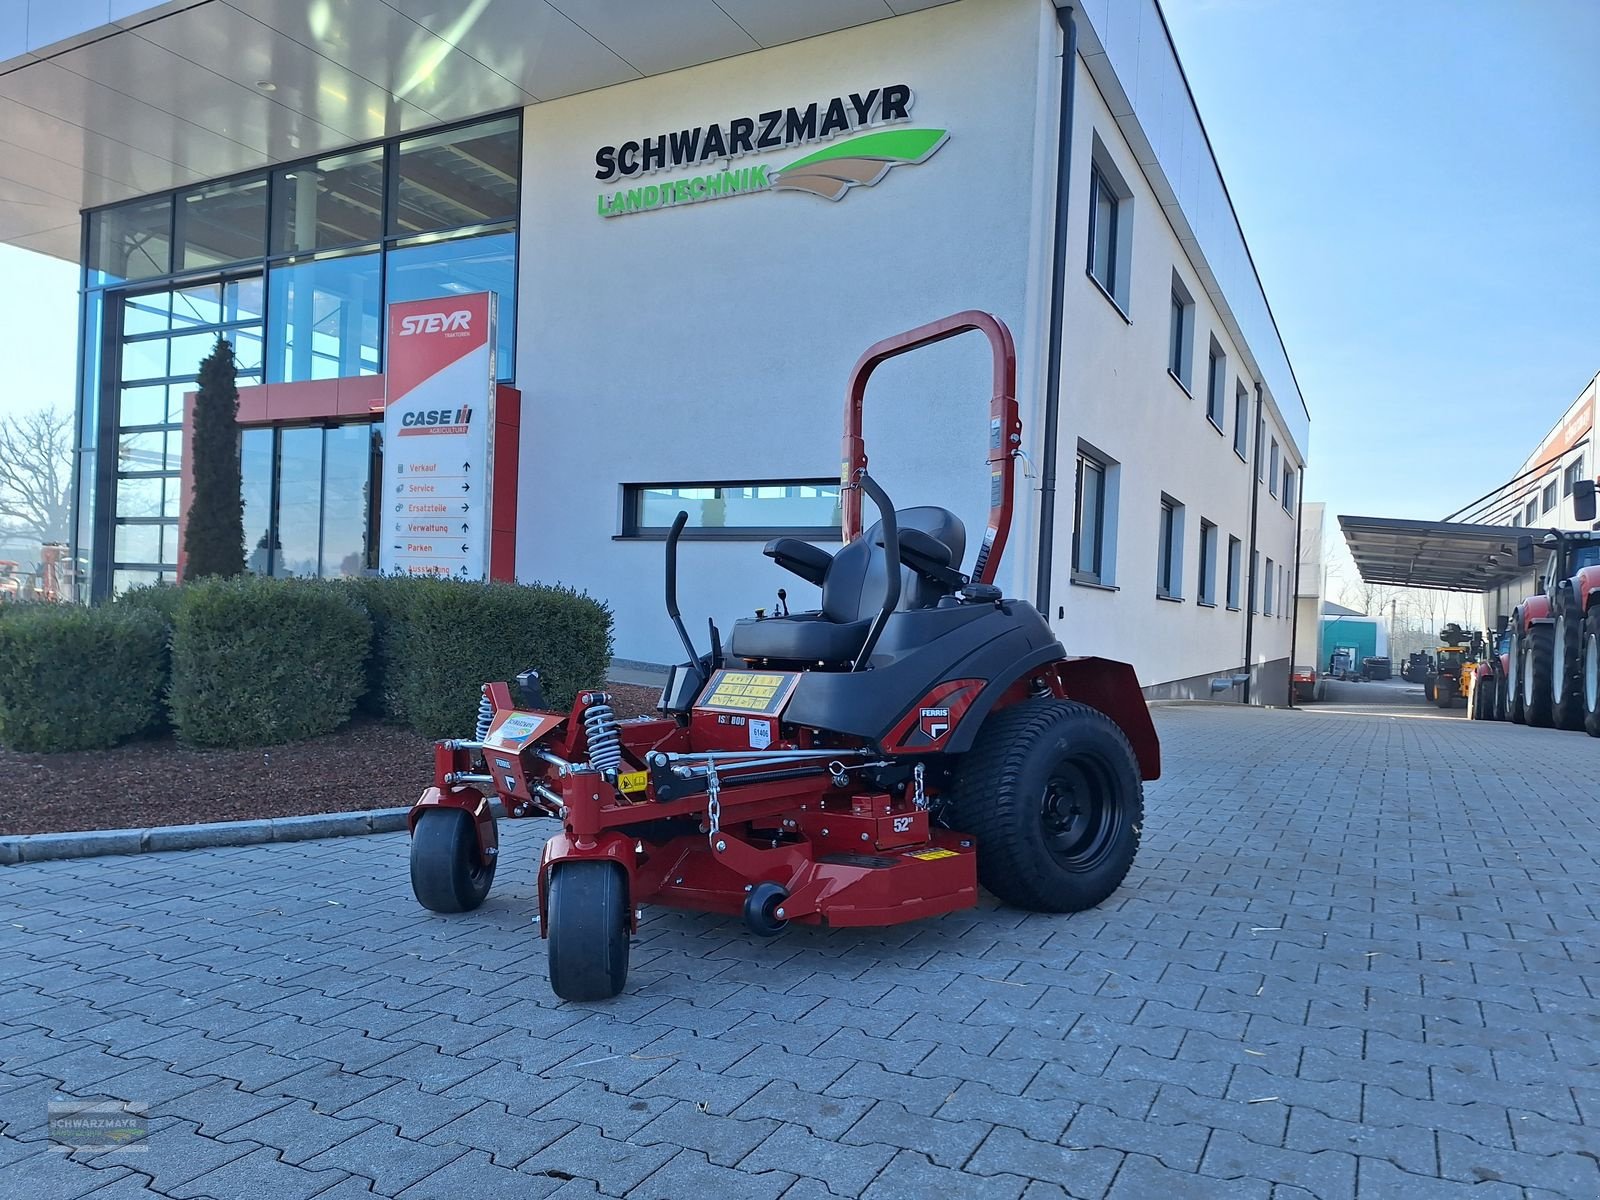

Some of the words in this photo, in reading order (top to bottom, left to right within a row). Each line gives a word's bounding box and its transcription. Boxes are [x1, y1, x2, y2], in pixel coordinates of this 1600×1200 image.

[595, 84, 912, 181] SCHWARZMAYR
[597, 164, 769, 217] LANDTECHNIK
[399, 310, 471, 336] STEYR
[402, 410, 452, 426] CASE
[409, 464, 437, 472] Verkauf
[409, 484, 435, 493] Service
[408, 504, 447, 513] Ersatzteile
[408, 523, 448, 534] Verwaltung
[407, 543, 433, 552] Parken
[921, 709, 948, 717] FERRIS
[893, 816, 914, 833] 52"
